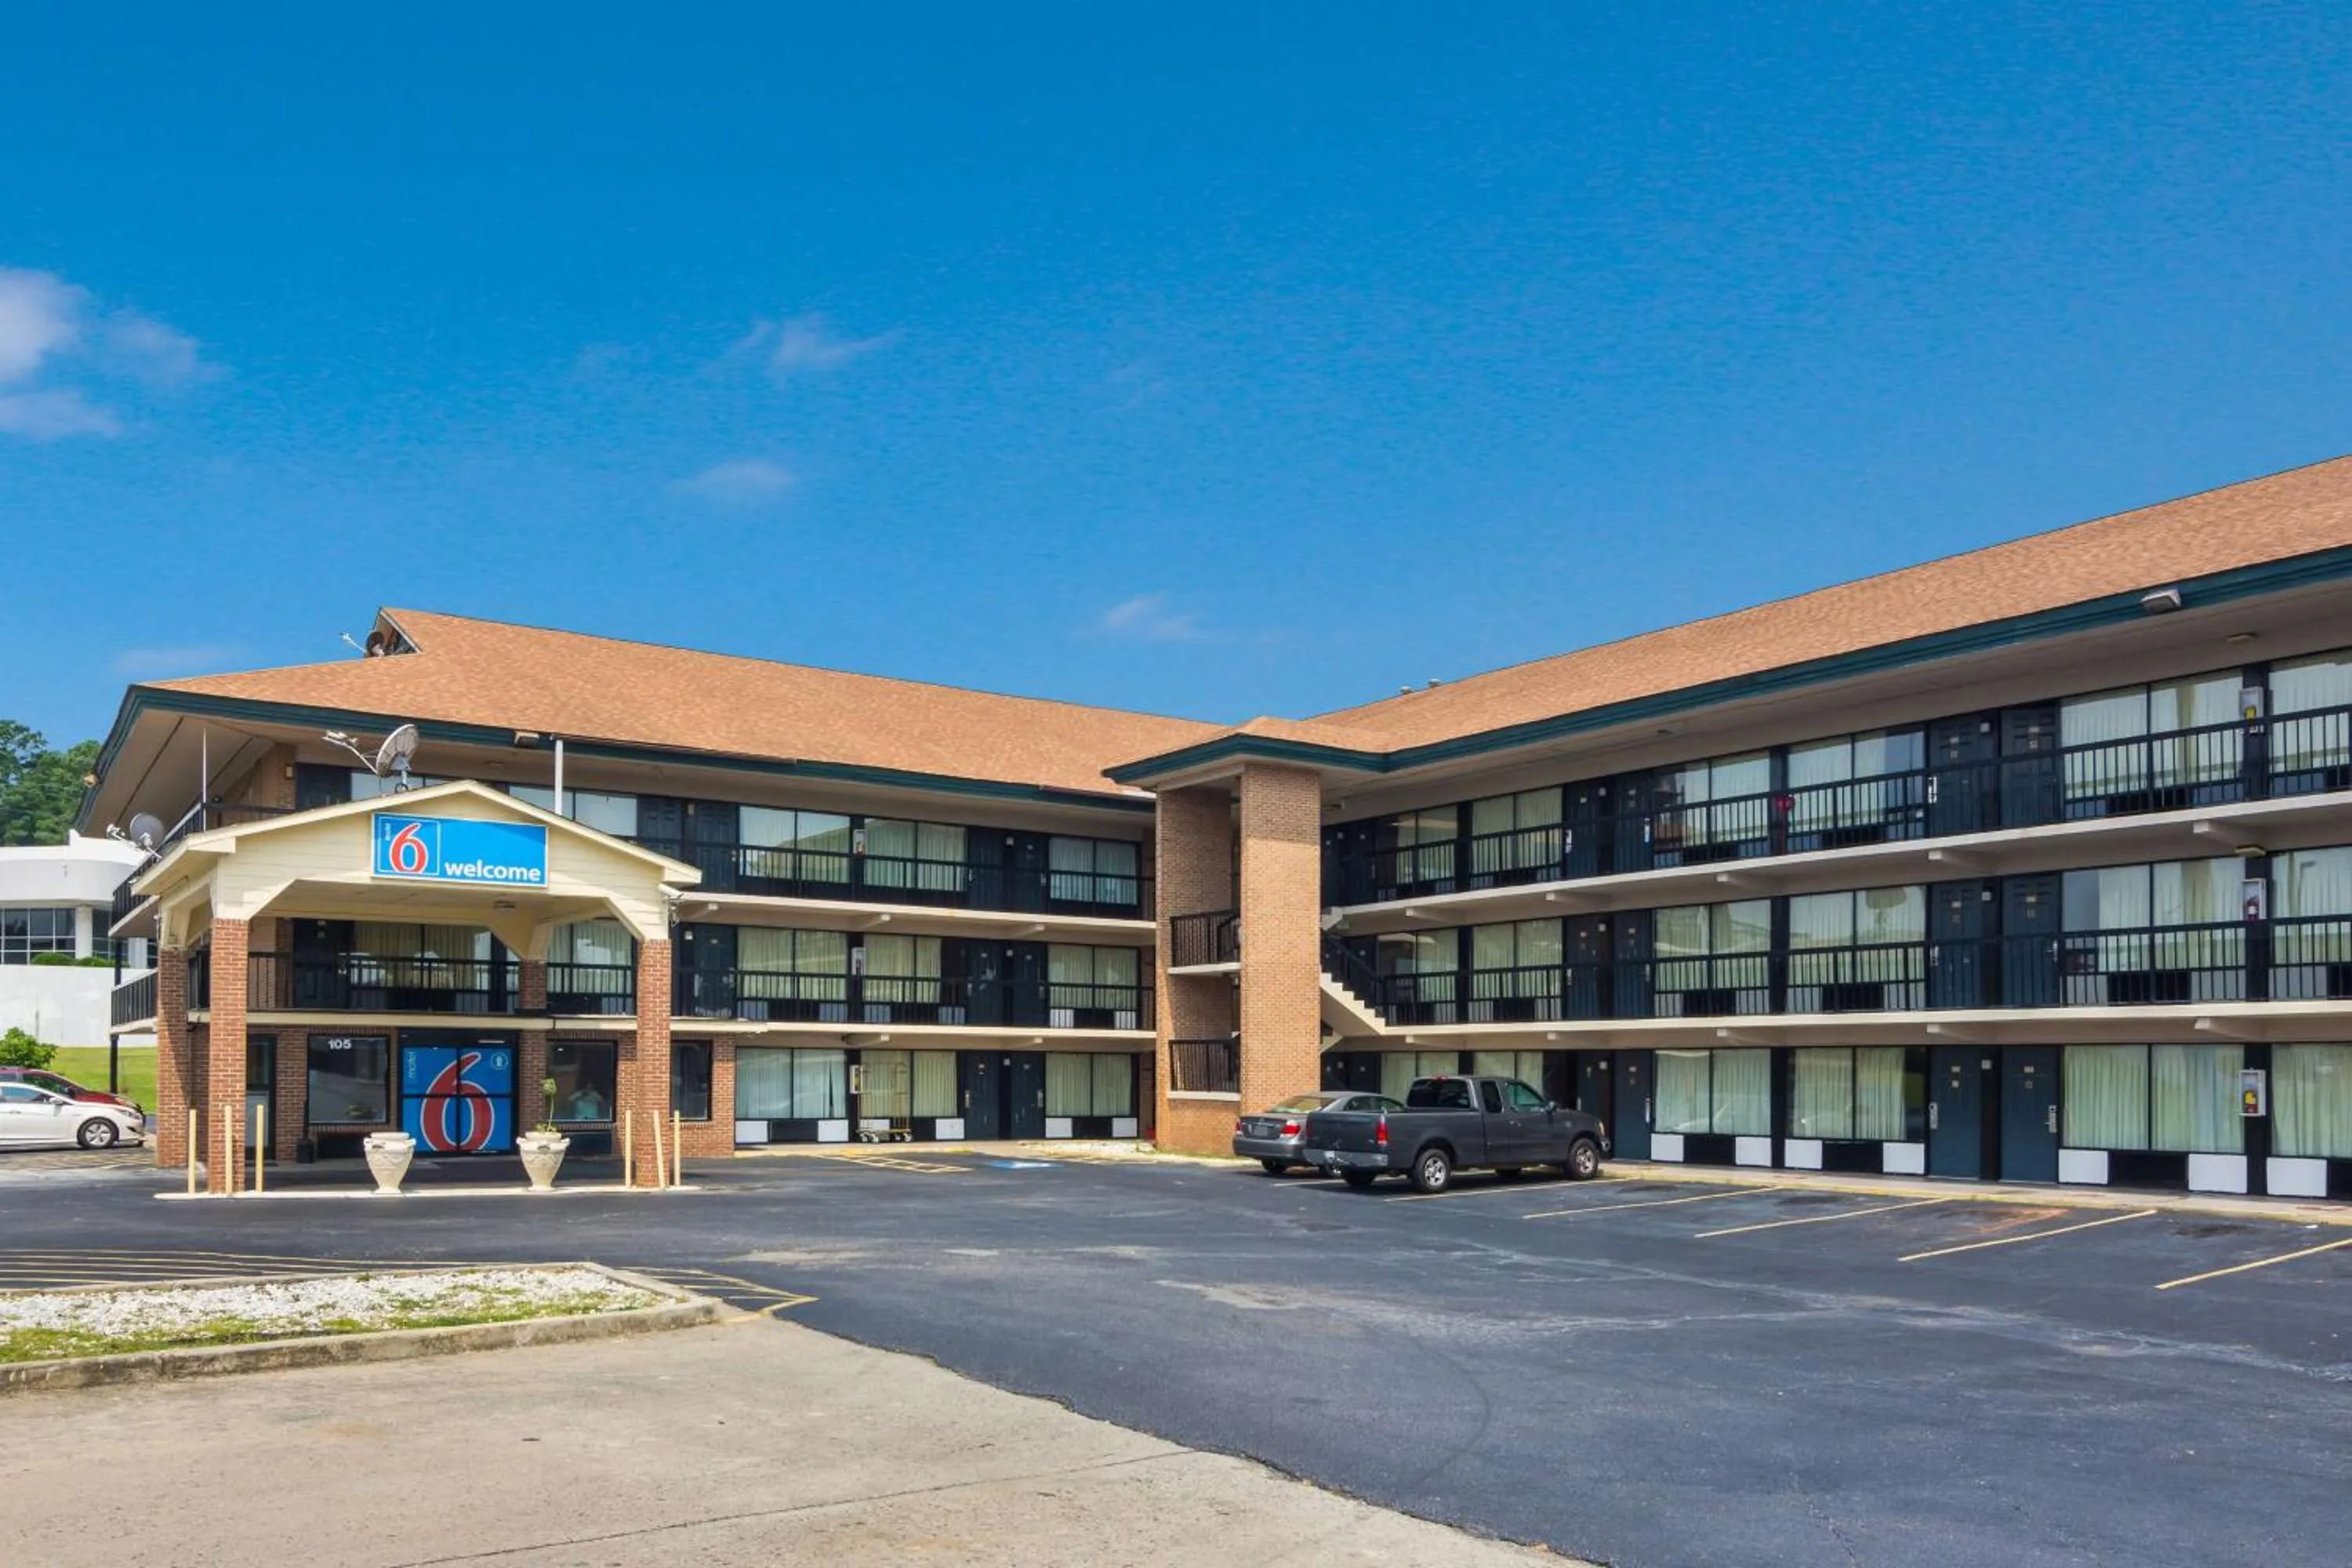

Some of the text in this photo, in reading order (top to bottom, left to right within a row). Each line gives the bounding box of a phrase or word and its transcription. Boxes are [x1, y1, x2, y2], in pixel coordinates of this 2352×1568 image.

[389, 822, 429, 873] 6
[445, 859, 541, 881] welcome
[327, 1039, 352, 1050] 105
[420, 1051, 495, 1151] 6
